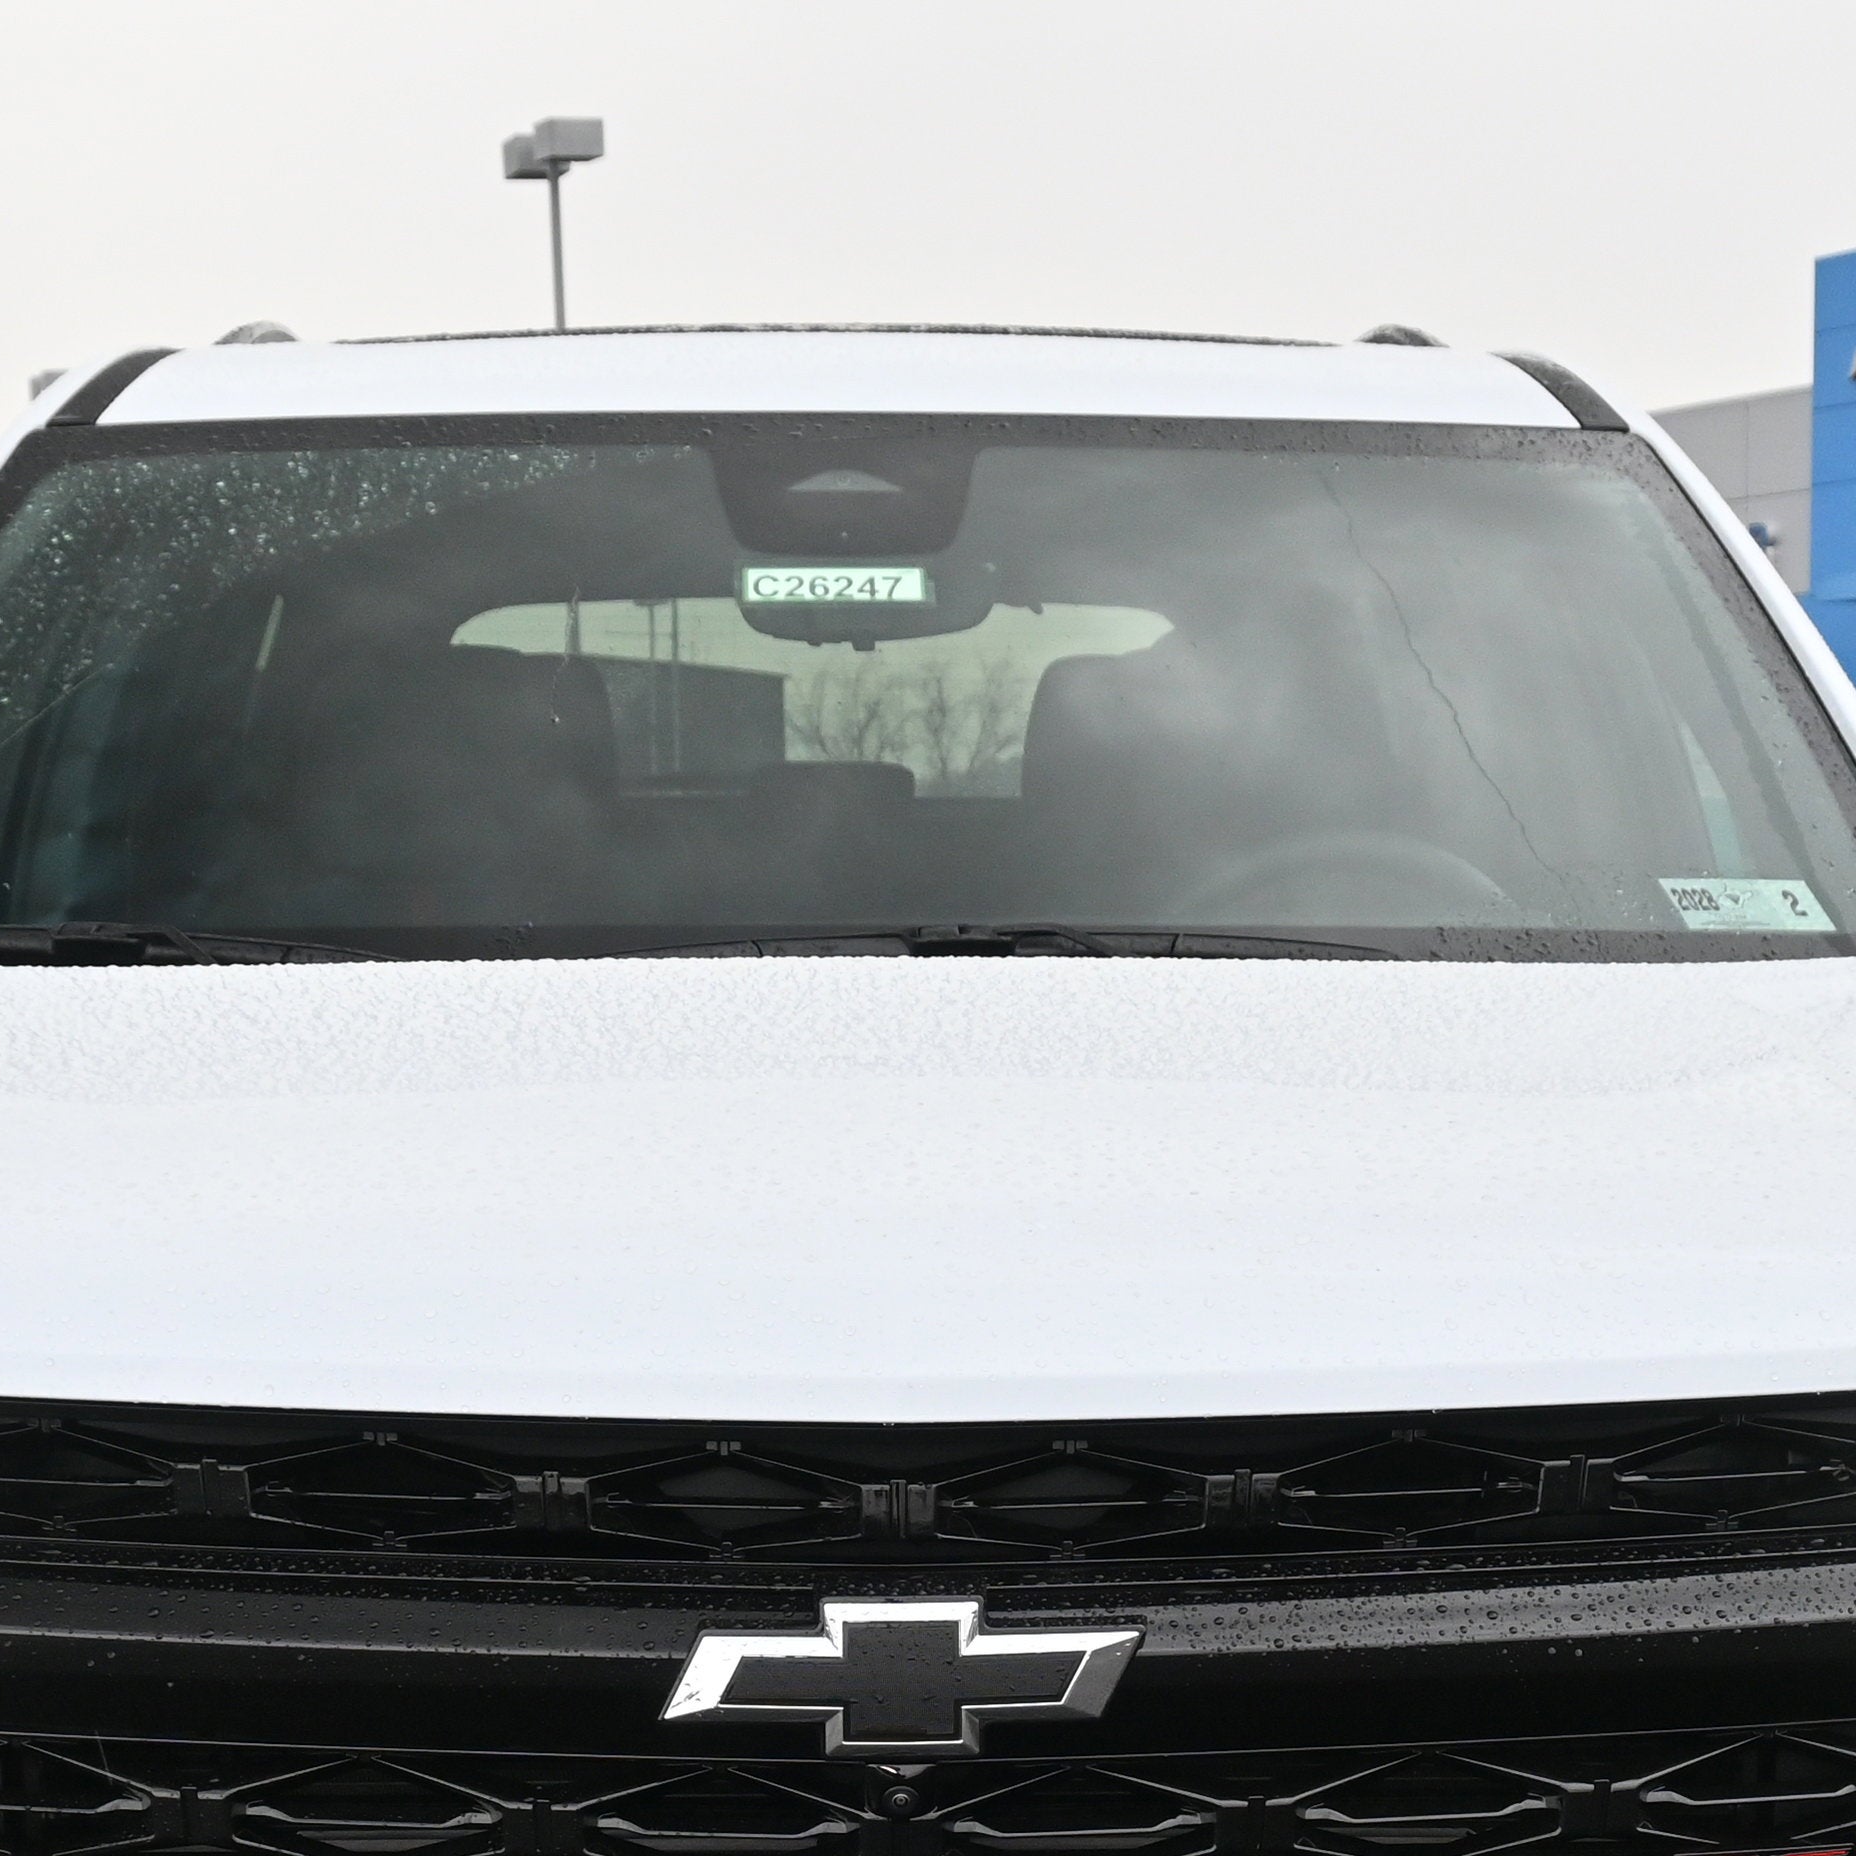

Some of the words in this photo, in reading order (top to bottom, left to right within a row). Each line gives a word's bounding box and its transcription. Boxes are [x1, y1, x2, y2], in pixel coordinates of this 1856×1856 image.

[752, 574, 903, 599] C26247
[1670, 888, 1720, 911] 2028
[1781, 890, 1809, 917] 2
